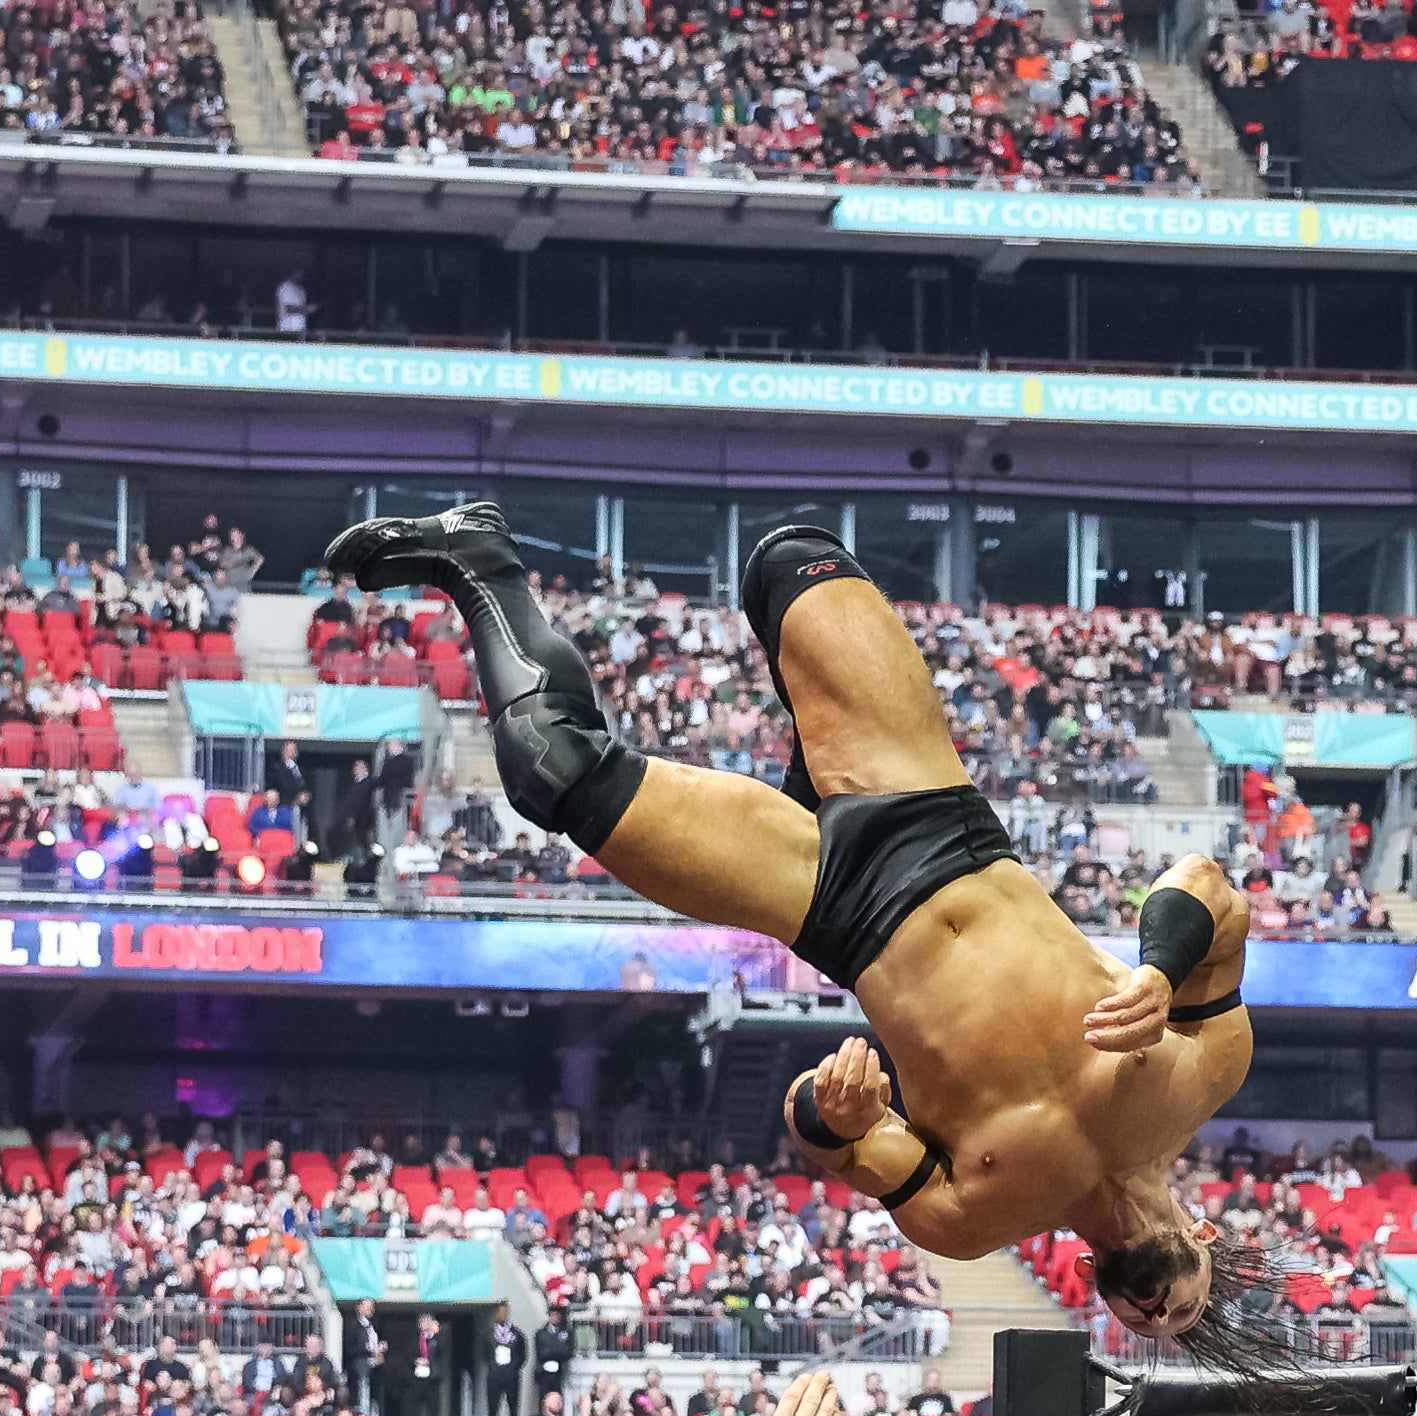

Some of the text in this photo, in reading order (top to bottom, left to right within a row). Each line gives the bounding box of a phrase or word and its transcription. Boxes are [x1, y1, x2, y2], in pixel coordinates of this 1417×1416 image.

[842, 195, 1291, 238] WEMBLEY CONNECTED BY EE
[0, 341, 36, 369] EE
[75, 347, 531, 390] WEMBLEY CONNECTED BY EE
[570, 368, 1014, 408] WEMBLEY CONNECTED BY EE
[1050, 385, 1200, 413] WEMBLEY
[1207, 390, 1402, 421] CONNECTED
[38, 919, 101, 967] IN
[112, 923, 323, 972] LONDON
